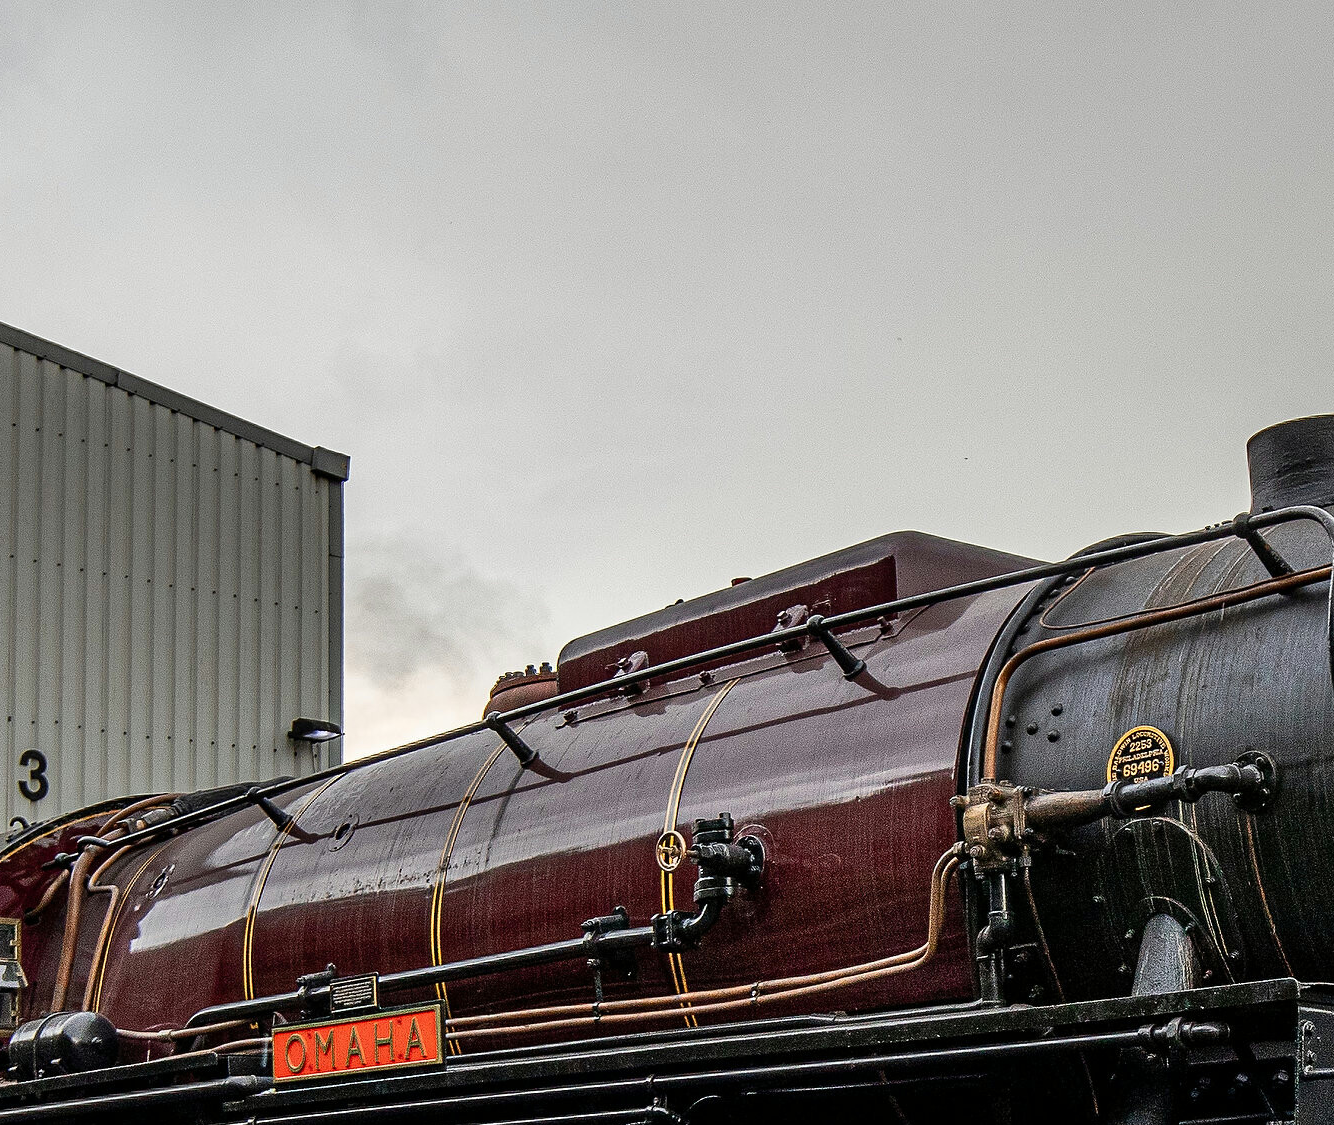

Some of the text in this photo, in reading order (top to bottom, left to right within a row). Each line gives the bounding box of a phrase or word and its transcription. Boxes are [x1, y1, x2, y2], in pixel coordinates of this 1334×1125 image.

[1129, 739, 1153, 753] 2253
[18, 749, 49, 802] 3
[1123, 758, 1160, 777] 69496
[285, 1016, 427, 1075] OMAHA
